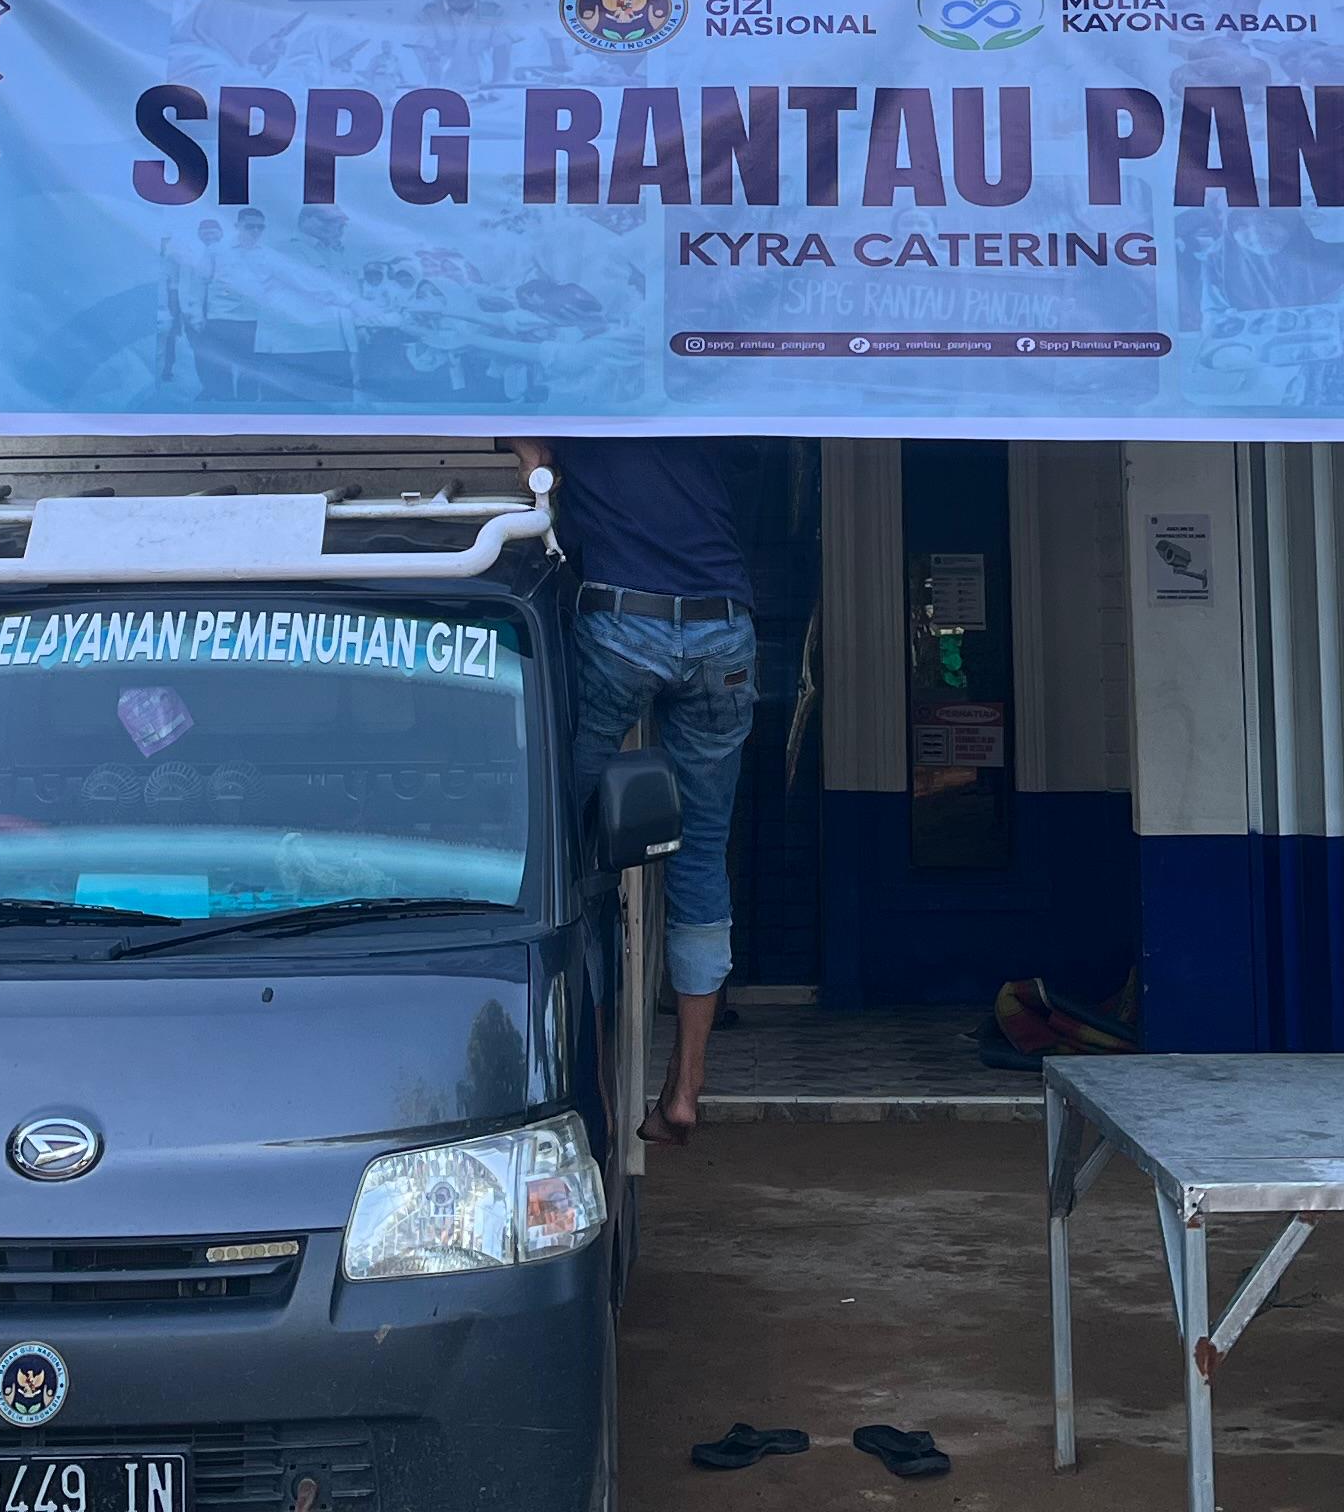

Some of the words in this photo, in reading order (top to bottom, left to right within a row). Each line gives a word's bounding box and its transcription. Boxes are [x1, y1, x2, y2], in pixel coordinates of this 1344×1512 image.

[568, 17, 617, 49] REPUBLIK
[622, 17, 678, 49] INDONESIA
[705, 14, 877, 37] NASIONAL
[1062, 13, 1205, 33] KAYONG
[1214, 13, 1317, 32] ABADI
[133, 85, 471, 206] SPPG
[523, 85, 1033, 206] RANTAU
[679, 232, 836, 267] KYRA
[853, 232, 1157, 267] CATERING
[784, 276, 854, 315] SPPG
[862, 280, 956, 321] RANTAU
[1039, 340, 1069, 351] Sppg
[1071, 340, 1112, 350] Rantau
[1114, 340, 1160, 351] Panjang
[190, 610, 419, 669] PEMENUHAN
[425, 621, 499, 679] GIZI
[37, 1347, 64, 1377] NASIONAL
[124, 1463, 172, 1512] IN
